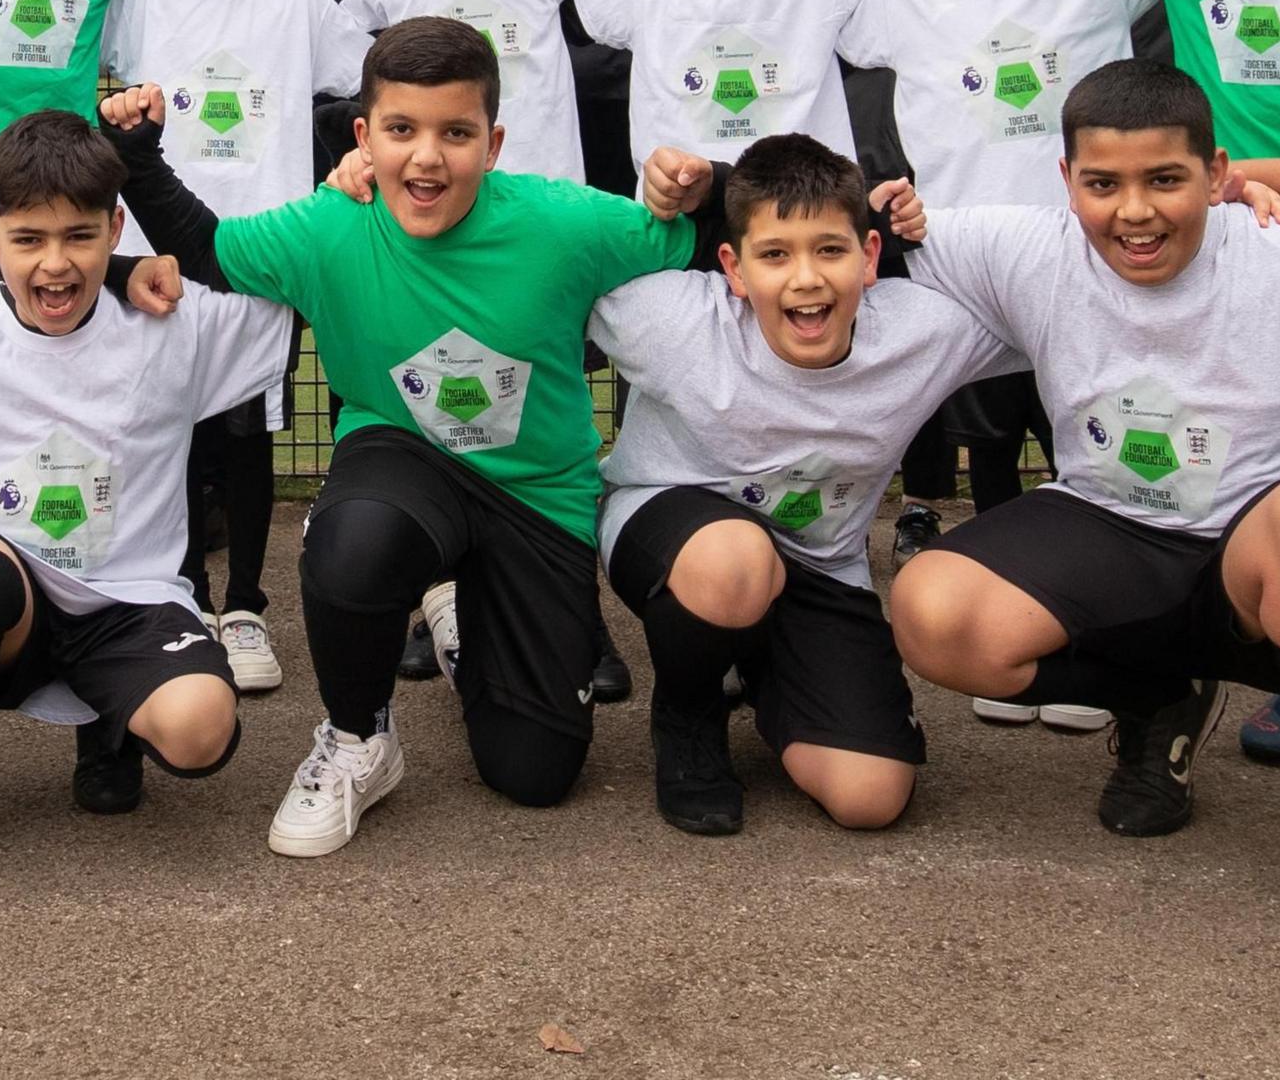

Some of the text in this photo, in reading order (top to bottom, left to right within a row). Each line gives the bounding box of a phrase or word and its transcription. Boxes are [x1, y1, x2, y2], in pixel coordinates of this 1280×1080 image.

[20, 6, 47, 14] FOOTBALL
[15, 14, 51, 24] FOUNDATION
[18, 44, 46, 52] TOGETHER
[12, 53, 51, 63] FOR FOOTBALL
[1244, 60, 1277, 69] TOGETHER
[1001, 74, 1030, 85] FOOTBALL
[720, 81, 748, 89] FOOTBALL
[999, 83, 1036, 96] FOUNDATION
[717, 90, 753, 99] FOUNDATION
[208, 102, 235, 110] FOOTBALL
[204, 110, 240, 119] FOUNDATION
[722, 119, 750, 128] TOGETHER
[1008, 114, 1038, 126] TOGETHER
[716, 128, 757, 138] FOR FOOTBALL
[1005, 123, 1046, 136] FOR FOOTBALL
[207, 140, 234, 148] TOGETHER
[201, 149, 240, 158] FOR FOOTBALL
[445, 388, 480, 398] FOOTBALL
[441, 397, 485, 407] FOUNDATION
[1133, 409, 1173, 418] Government
[449, 427, 484, 437] TOGETHER
[443, 436, 492, 448] FOR FOOTBALL
[1129, 442, 1166, 455] FOOTBALL
[1125, 452, 1173, 467] FOUNDATION
[1133, 486, 1171, 500] TOGETHER
[42, 499, 77, 509] FOOTBALL
[1128, 494, 1181, 511] FOR FOOTBALL
[37, 510, 81, 521] FOUNDATION
[40, 547, 76, 557] TOGETHER
